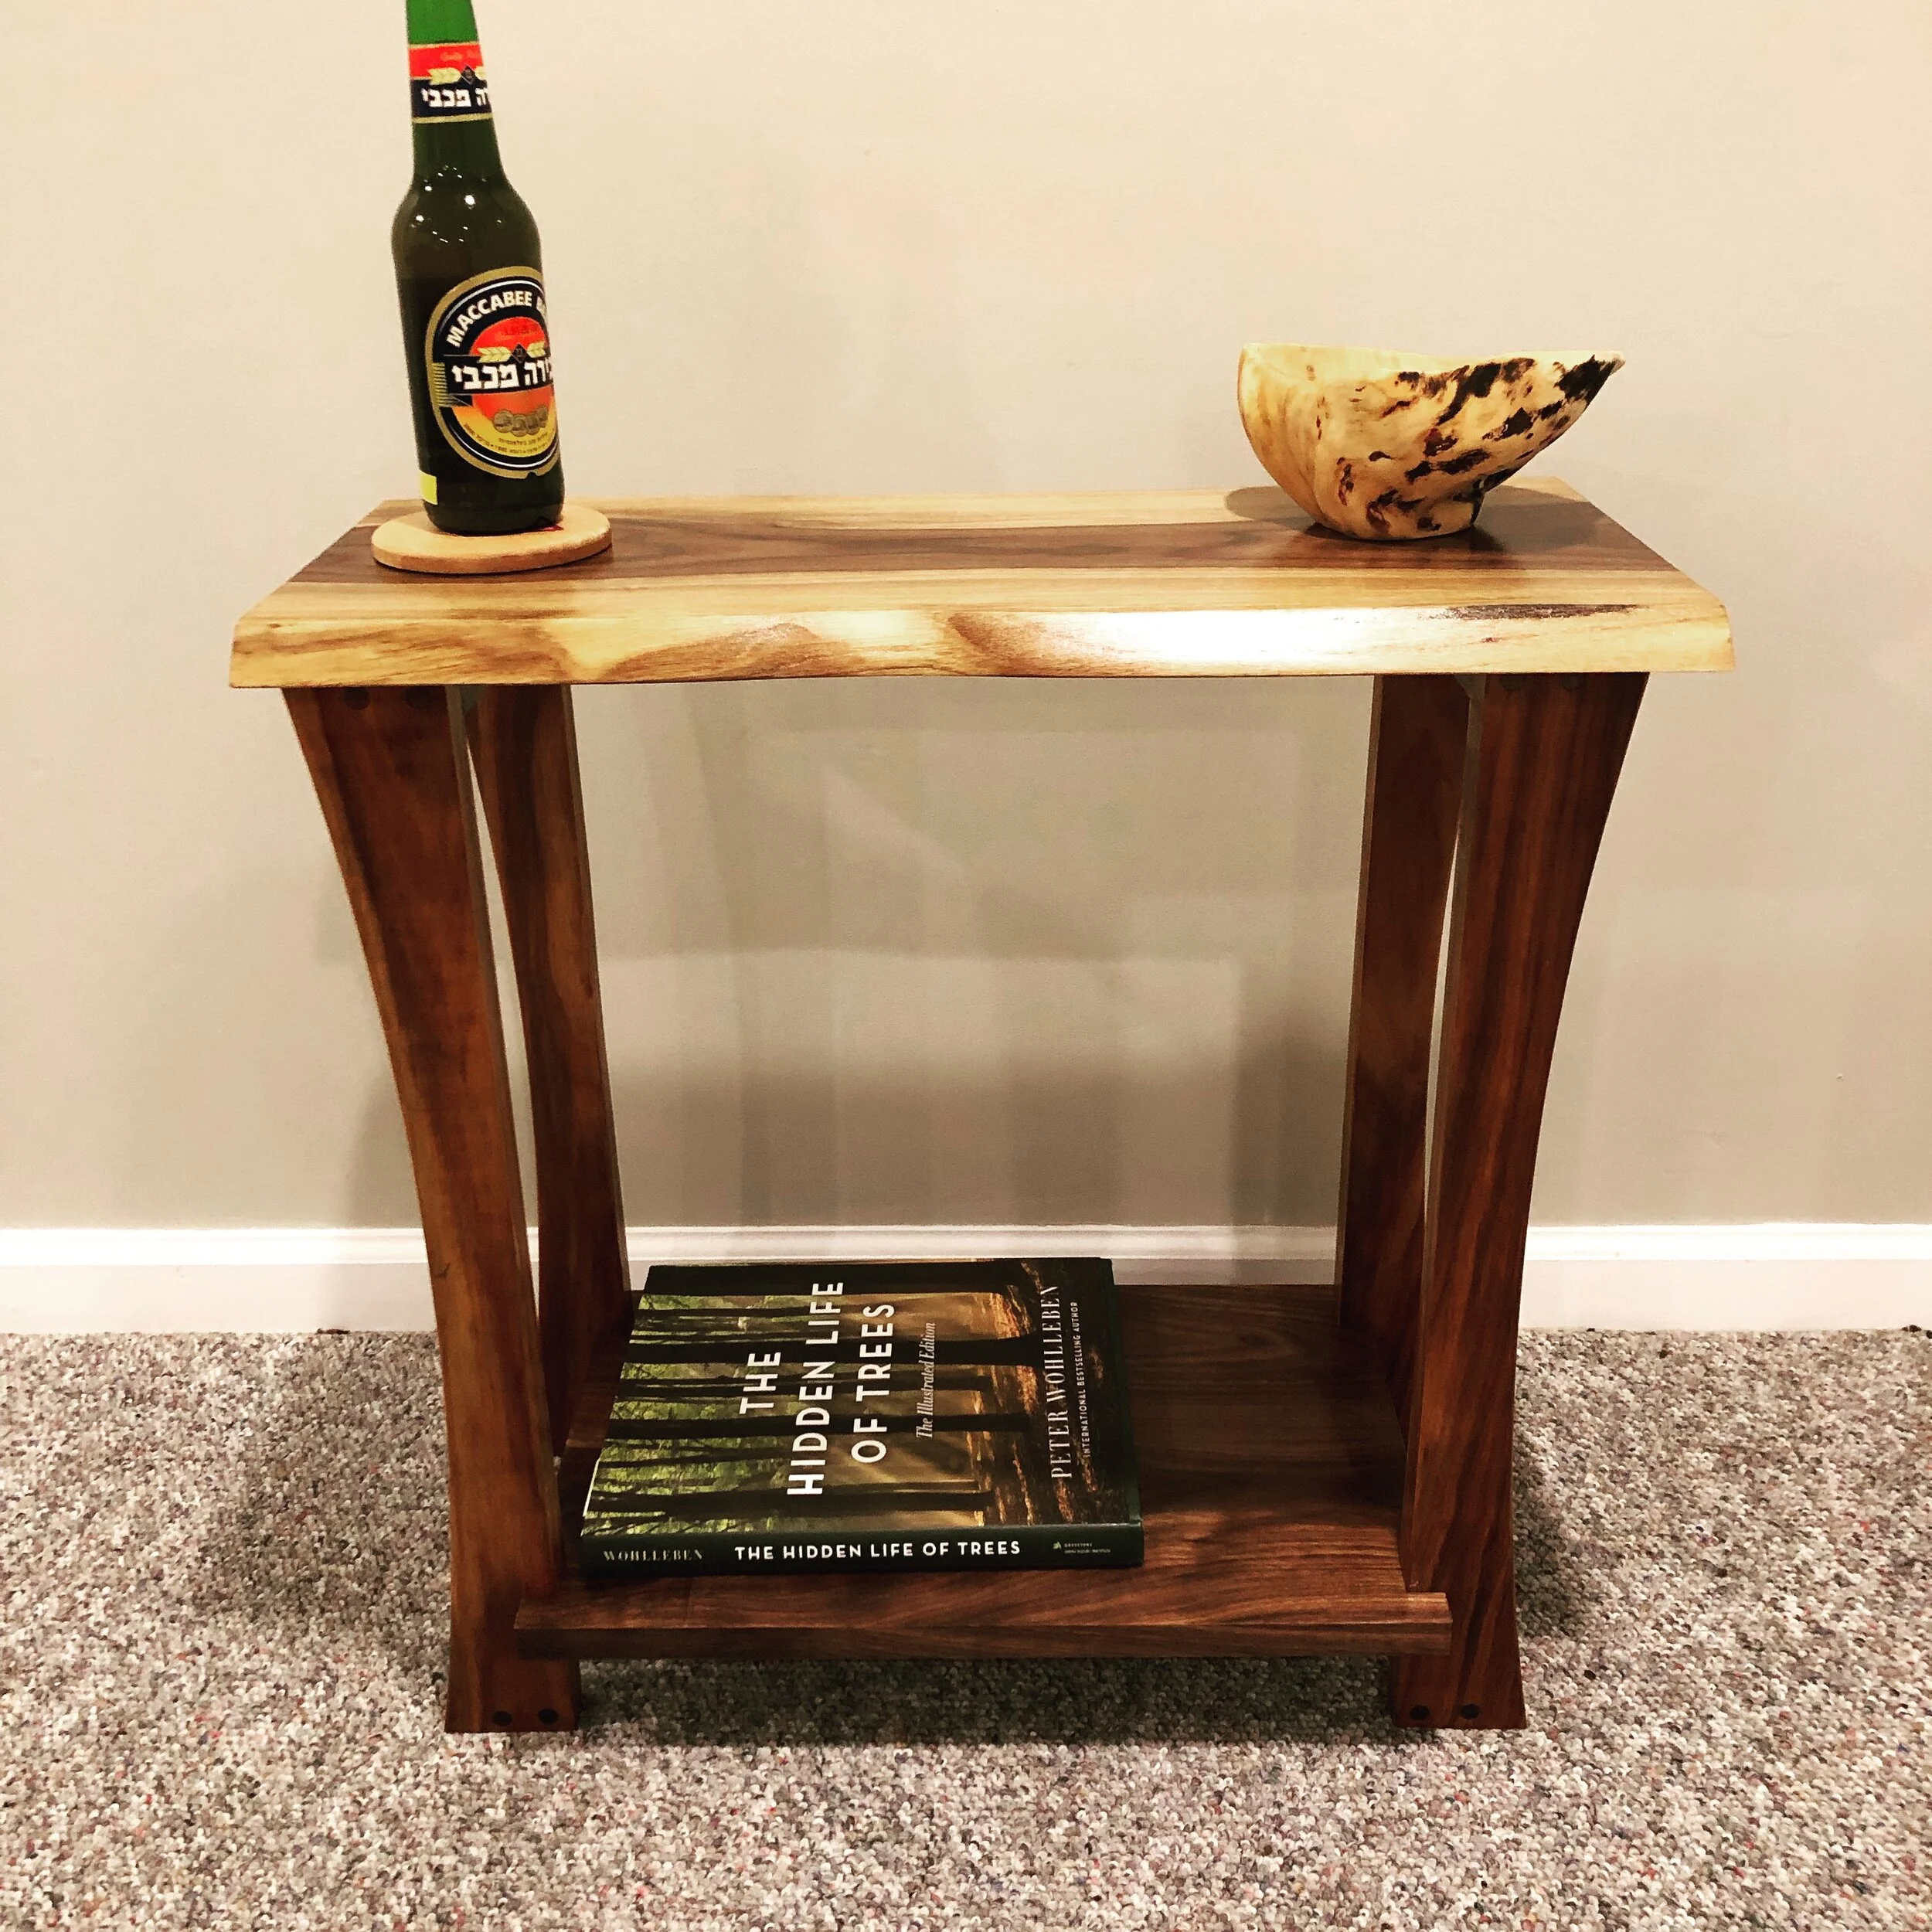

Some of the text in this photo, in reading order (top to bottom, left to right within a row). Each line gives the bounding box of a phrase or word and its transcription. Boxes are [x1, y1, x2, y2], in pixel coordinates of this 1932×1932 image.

[420, 87, 471, 107] מכבי
[446, 291, 532, 348] MACCABEE
[451, 364, 520, 389] מכבי
[739, 1352, 781, 1414] THE
[787, 1282, 843, 1495] HIDDEN LIFE
[851, 1304, 895, 1463] OF TREES
[916, 1322, 936, 1438] The Illustrated Edition
[1040, 1286, 1073, 1479] PETER WOHLLEBEN
[1070, 1301, 1091, 1458] INTERNATIONAL BESTSELLING AUTHOR
[604, 1548, 703, 1562] WOHLLEBEN
[734, 1540, 1020, 1561] THE HIDDEN LIFE OF TREES
